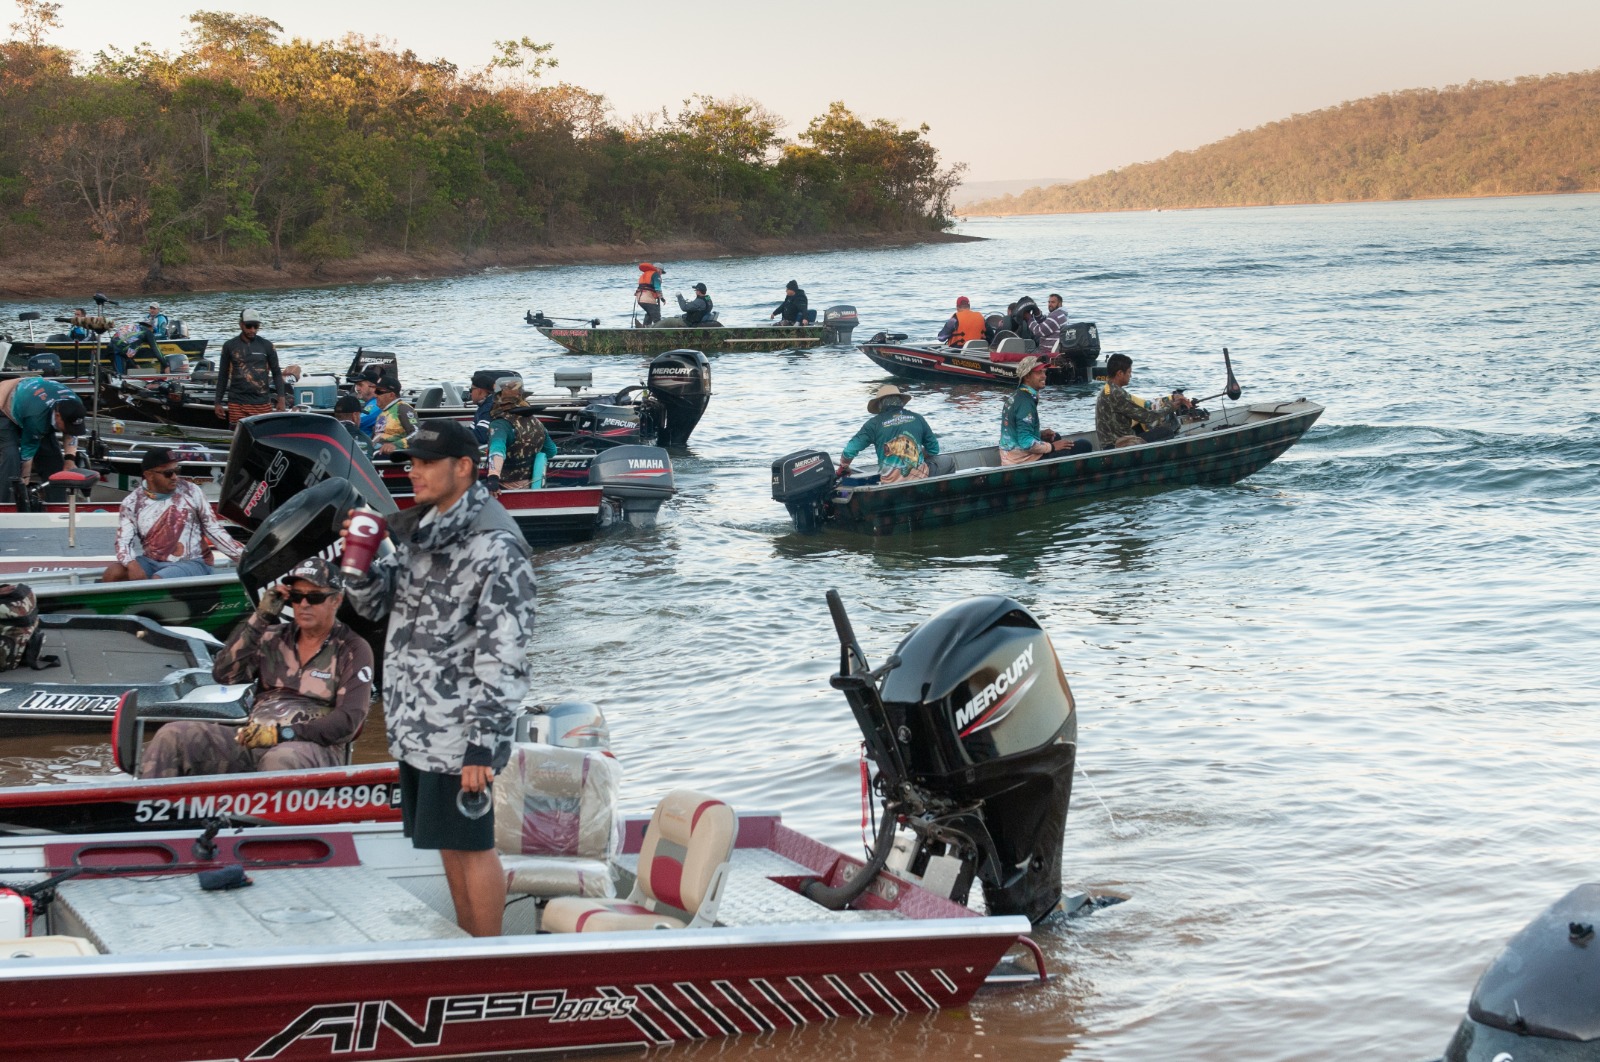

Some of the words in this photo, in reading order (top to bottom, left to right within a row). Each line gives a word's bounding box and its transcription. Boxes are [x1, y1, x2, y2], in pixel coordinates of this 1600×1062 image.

[652, 367, 692, 375] MERCURY
[602, 417, 638, 429] MERCURY
[546, 460, 589, 469] vefort
[628, 459, 664, 469] YAMAHA
[794, 455, 820, 468] MERCURY
[244, 480, 268, 517] PRO
[955, 643, 1034, 730] MERCURY
[134, 784, 388, 823] 521M2021004896
[549, 996, 638, 1023] BASS
